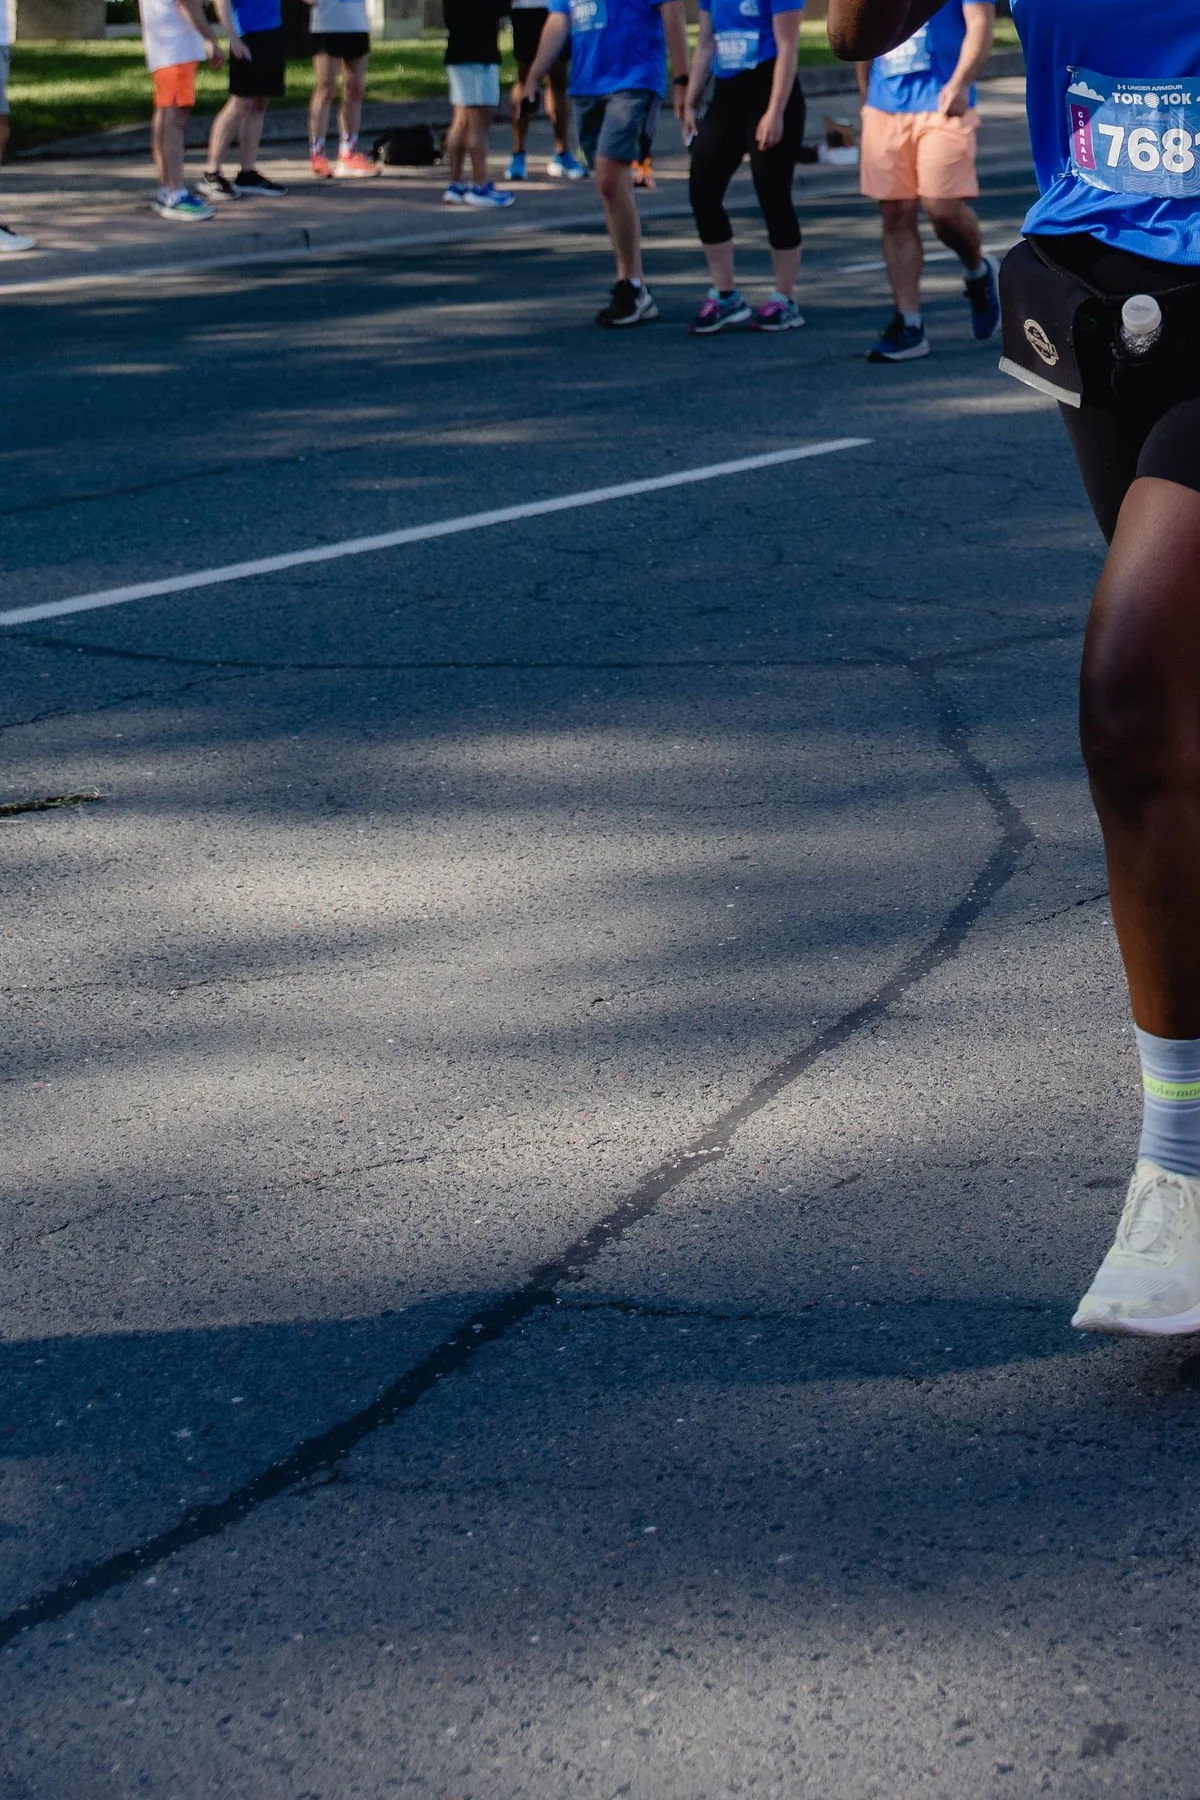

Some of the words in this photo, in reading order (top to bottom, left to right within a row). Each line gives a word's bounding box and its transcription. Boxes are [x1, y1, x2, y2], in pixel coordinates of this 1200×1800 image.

[1112, 92, 1143, 105] TOR
[1160, 92, 1192, 105] 10K
[1077, 111, 1088, 163] CORRAL
